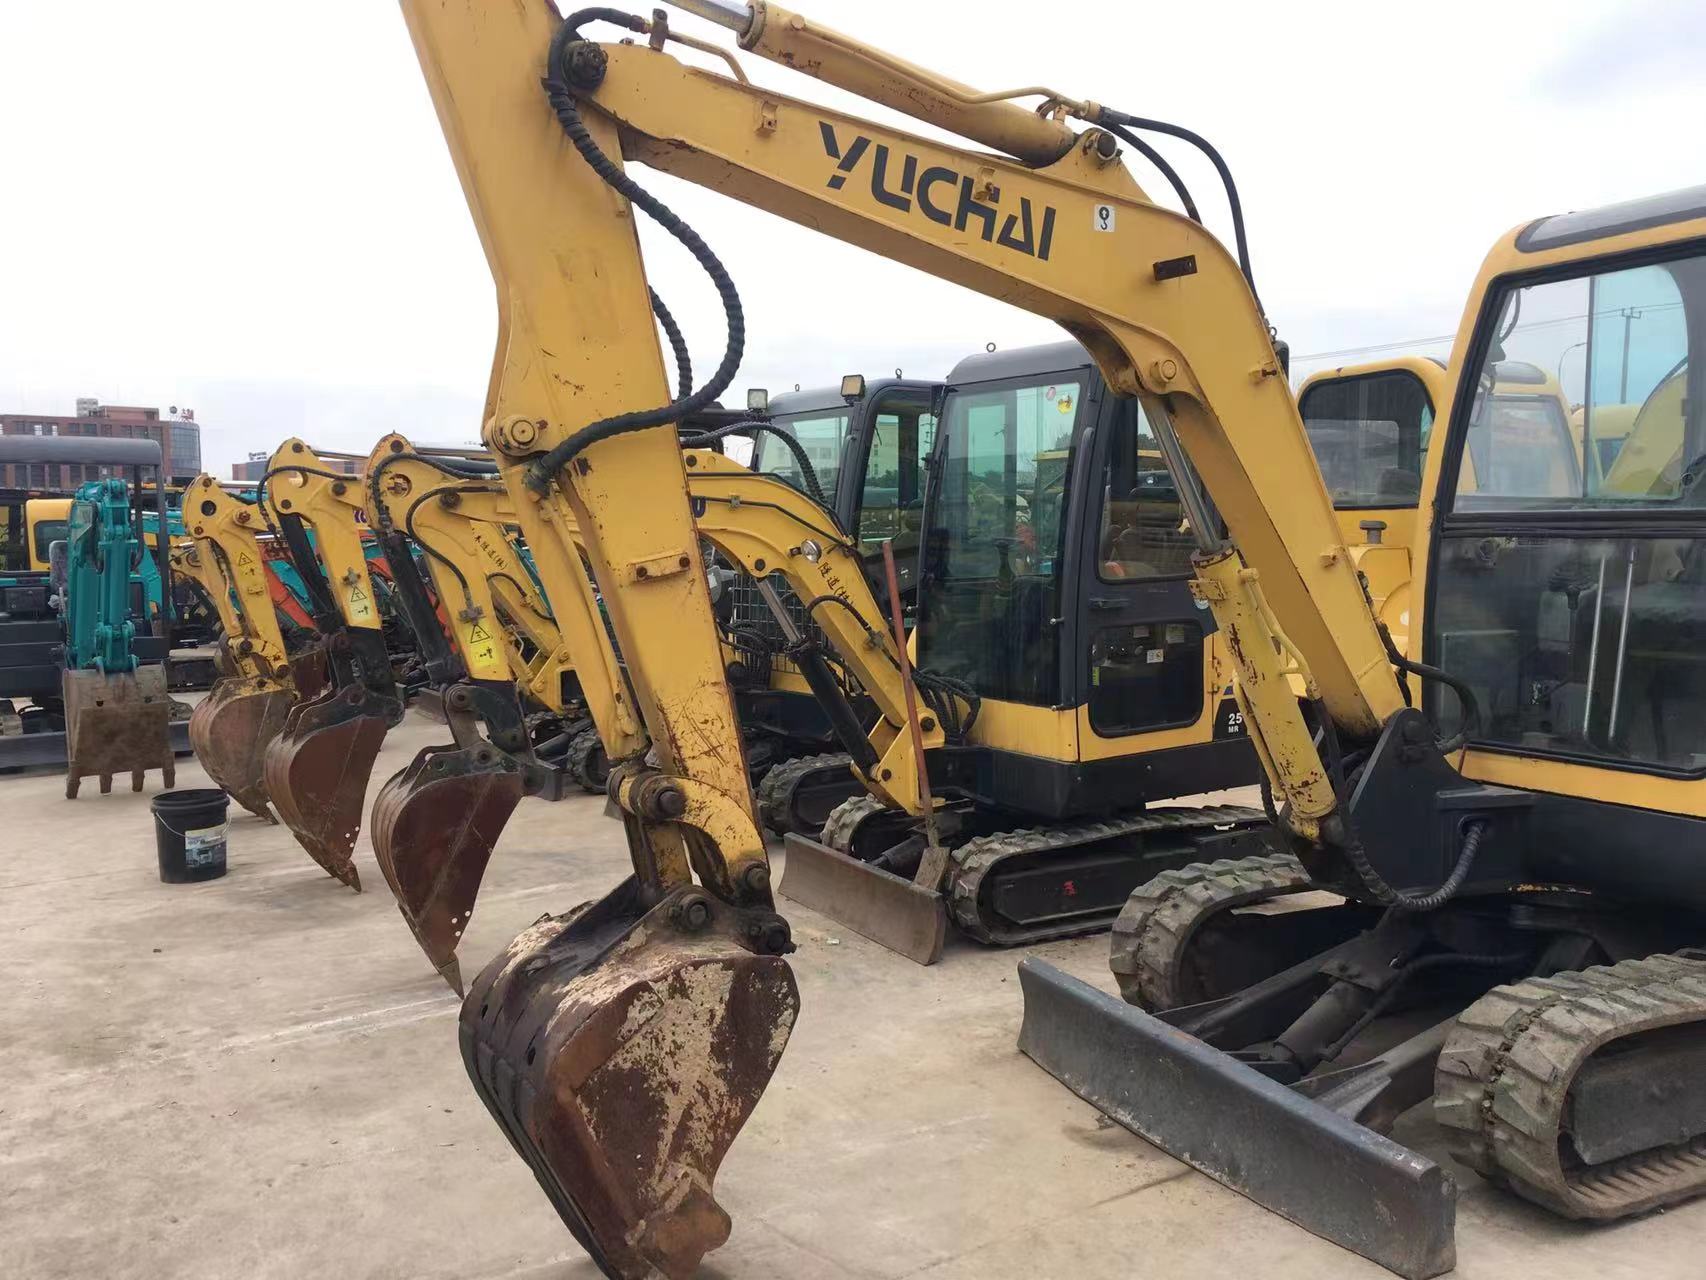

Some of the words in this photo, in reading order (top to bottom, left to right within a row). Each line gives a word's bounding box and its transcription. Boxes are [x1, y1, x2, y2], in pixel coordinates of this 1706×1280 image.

[819, 121, 1057, 262] YUCHAI
[1229, 713, 1245, 727] 25
[1228, 727, 1240, 736] MR
